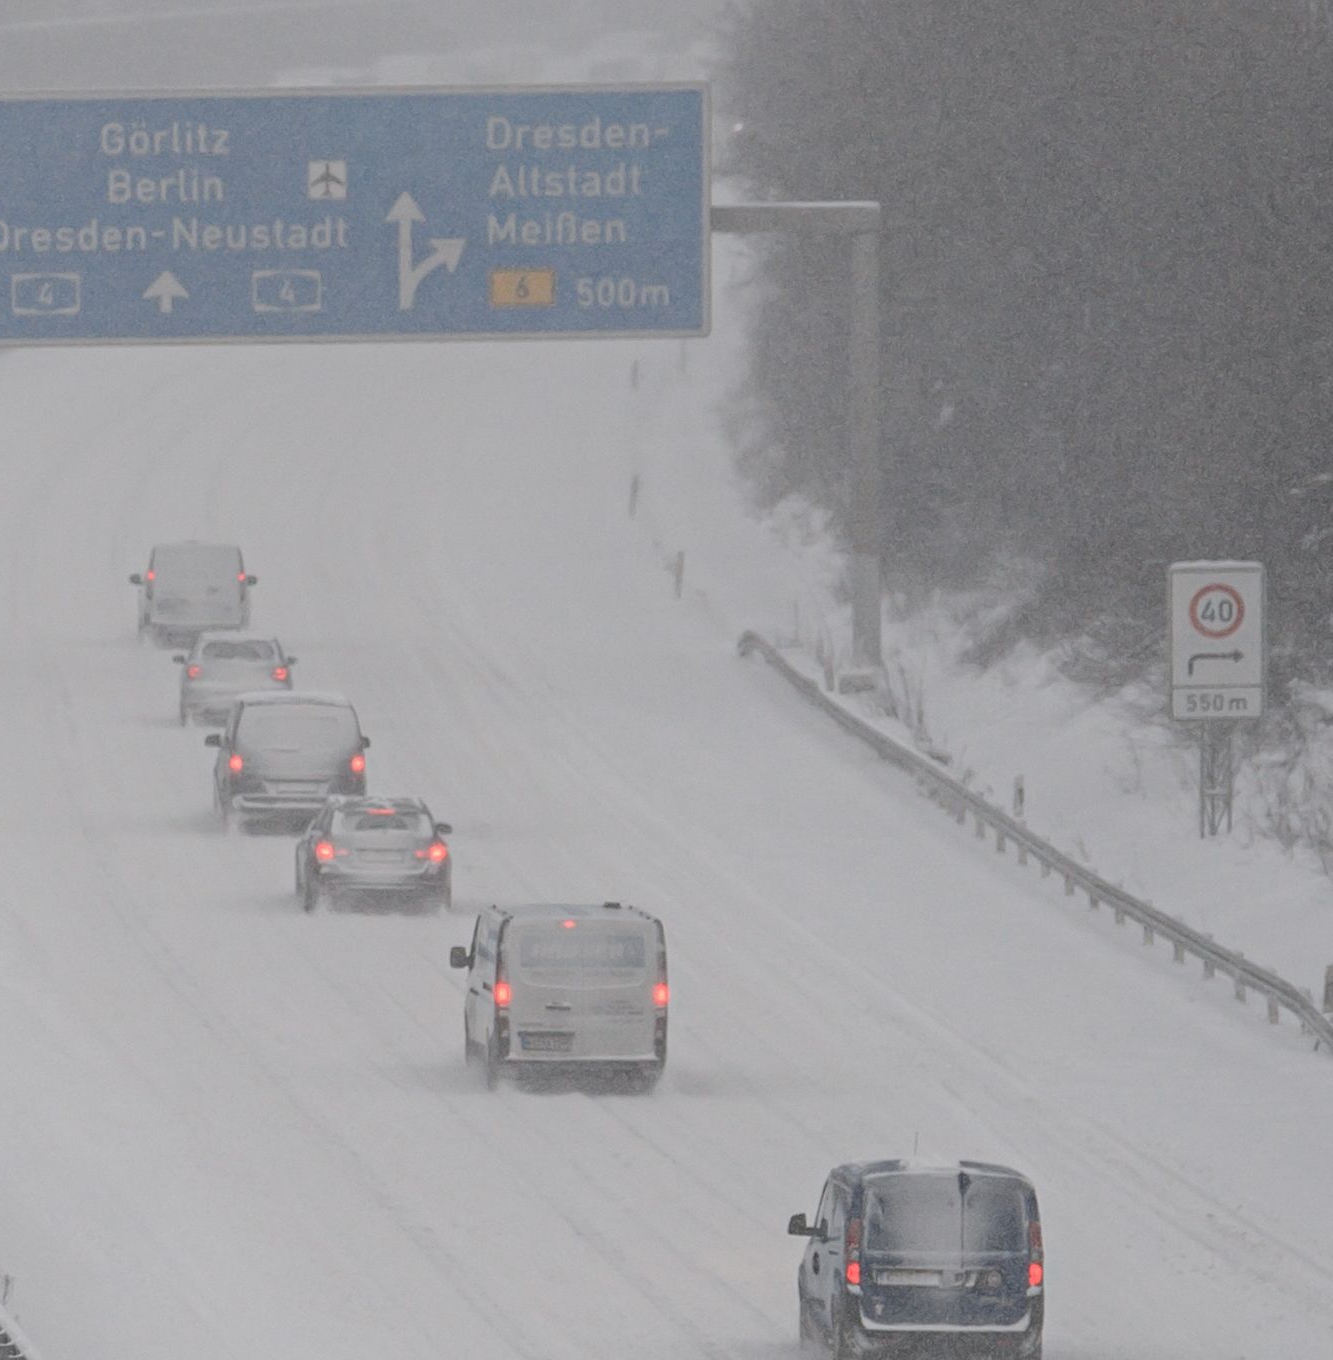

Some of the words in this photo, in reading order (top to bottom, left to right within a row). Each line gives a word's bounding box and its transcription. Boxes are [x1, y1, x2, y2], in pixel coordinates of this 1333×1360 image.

[100, 119, 230, 154] Görlitz
[486, 116, 670, 150] Dresden-
[107, 169, 224, 203] Berlin
[488, 162, 643, 197] Altstadt
[487, 211, 627, 245] Meißen
[38, 281, 54, 305] 4
[279, 280, 296, 303] 4
[515, 276, 530, 299] 6
[1201, 600, 1233, 622] 40
